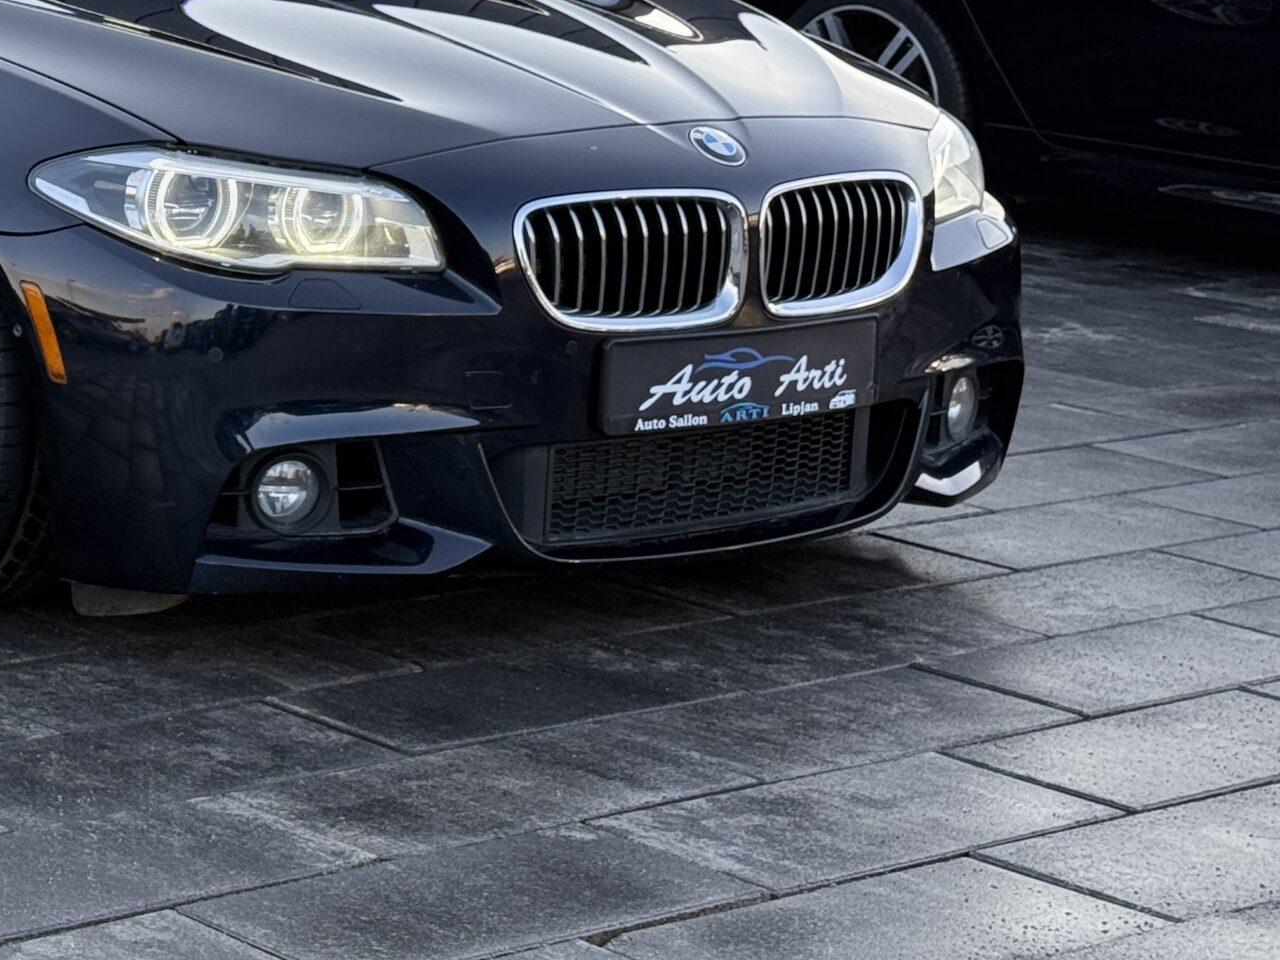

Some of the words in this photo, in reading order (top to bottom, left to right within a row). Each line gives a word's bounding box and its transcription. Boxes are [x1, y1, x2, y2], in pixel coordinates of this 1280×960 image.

[638, 363, 752, 411] Auto
[774, 355, 847, 397] Arti
[720, 406, 769, 423] ARTI
[781, 401, 819, 416] Lipjan
[634, 418, 667, 431] Auto
[668, 413, 708, 429] Sallon
